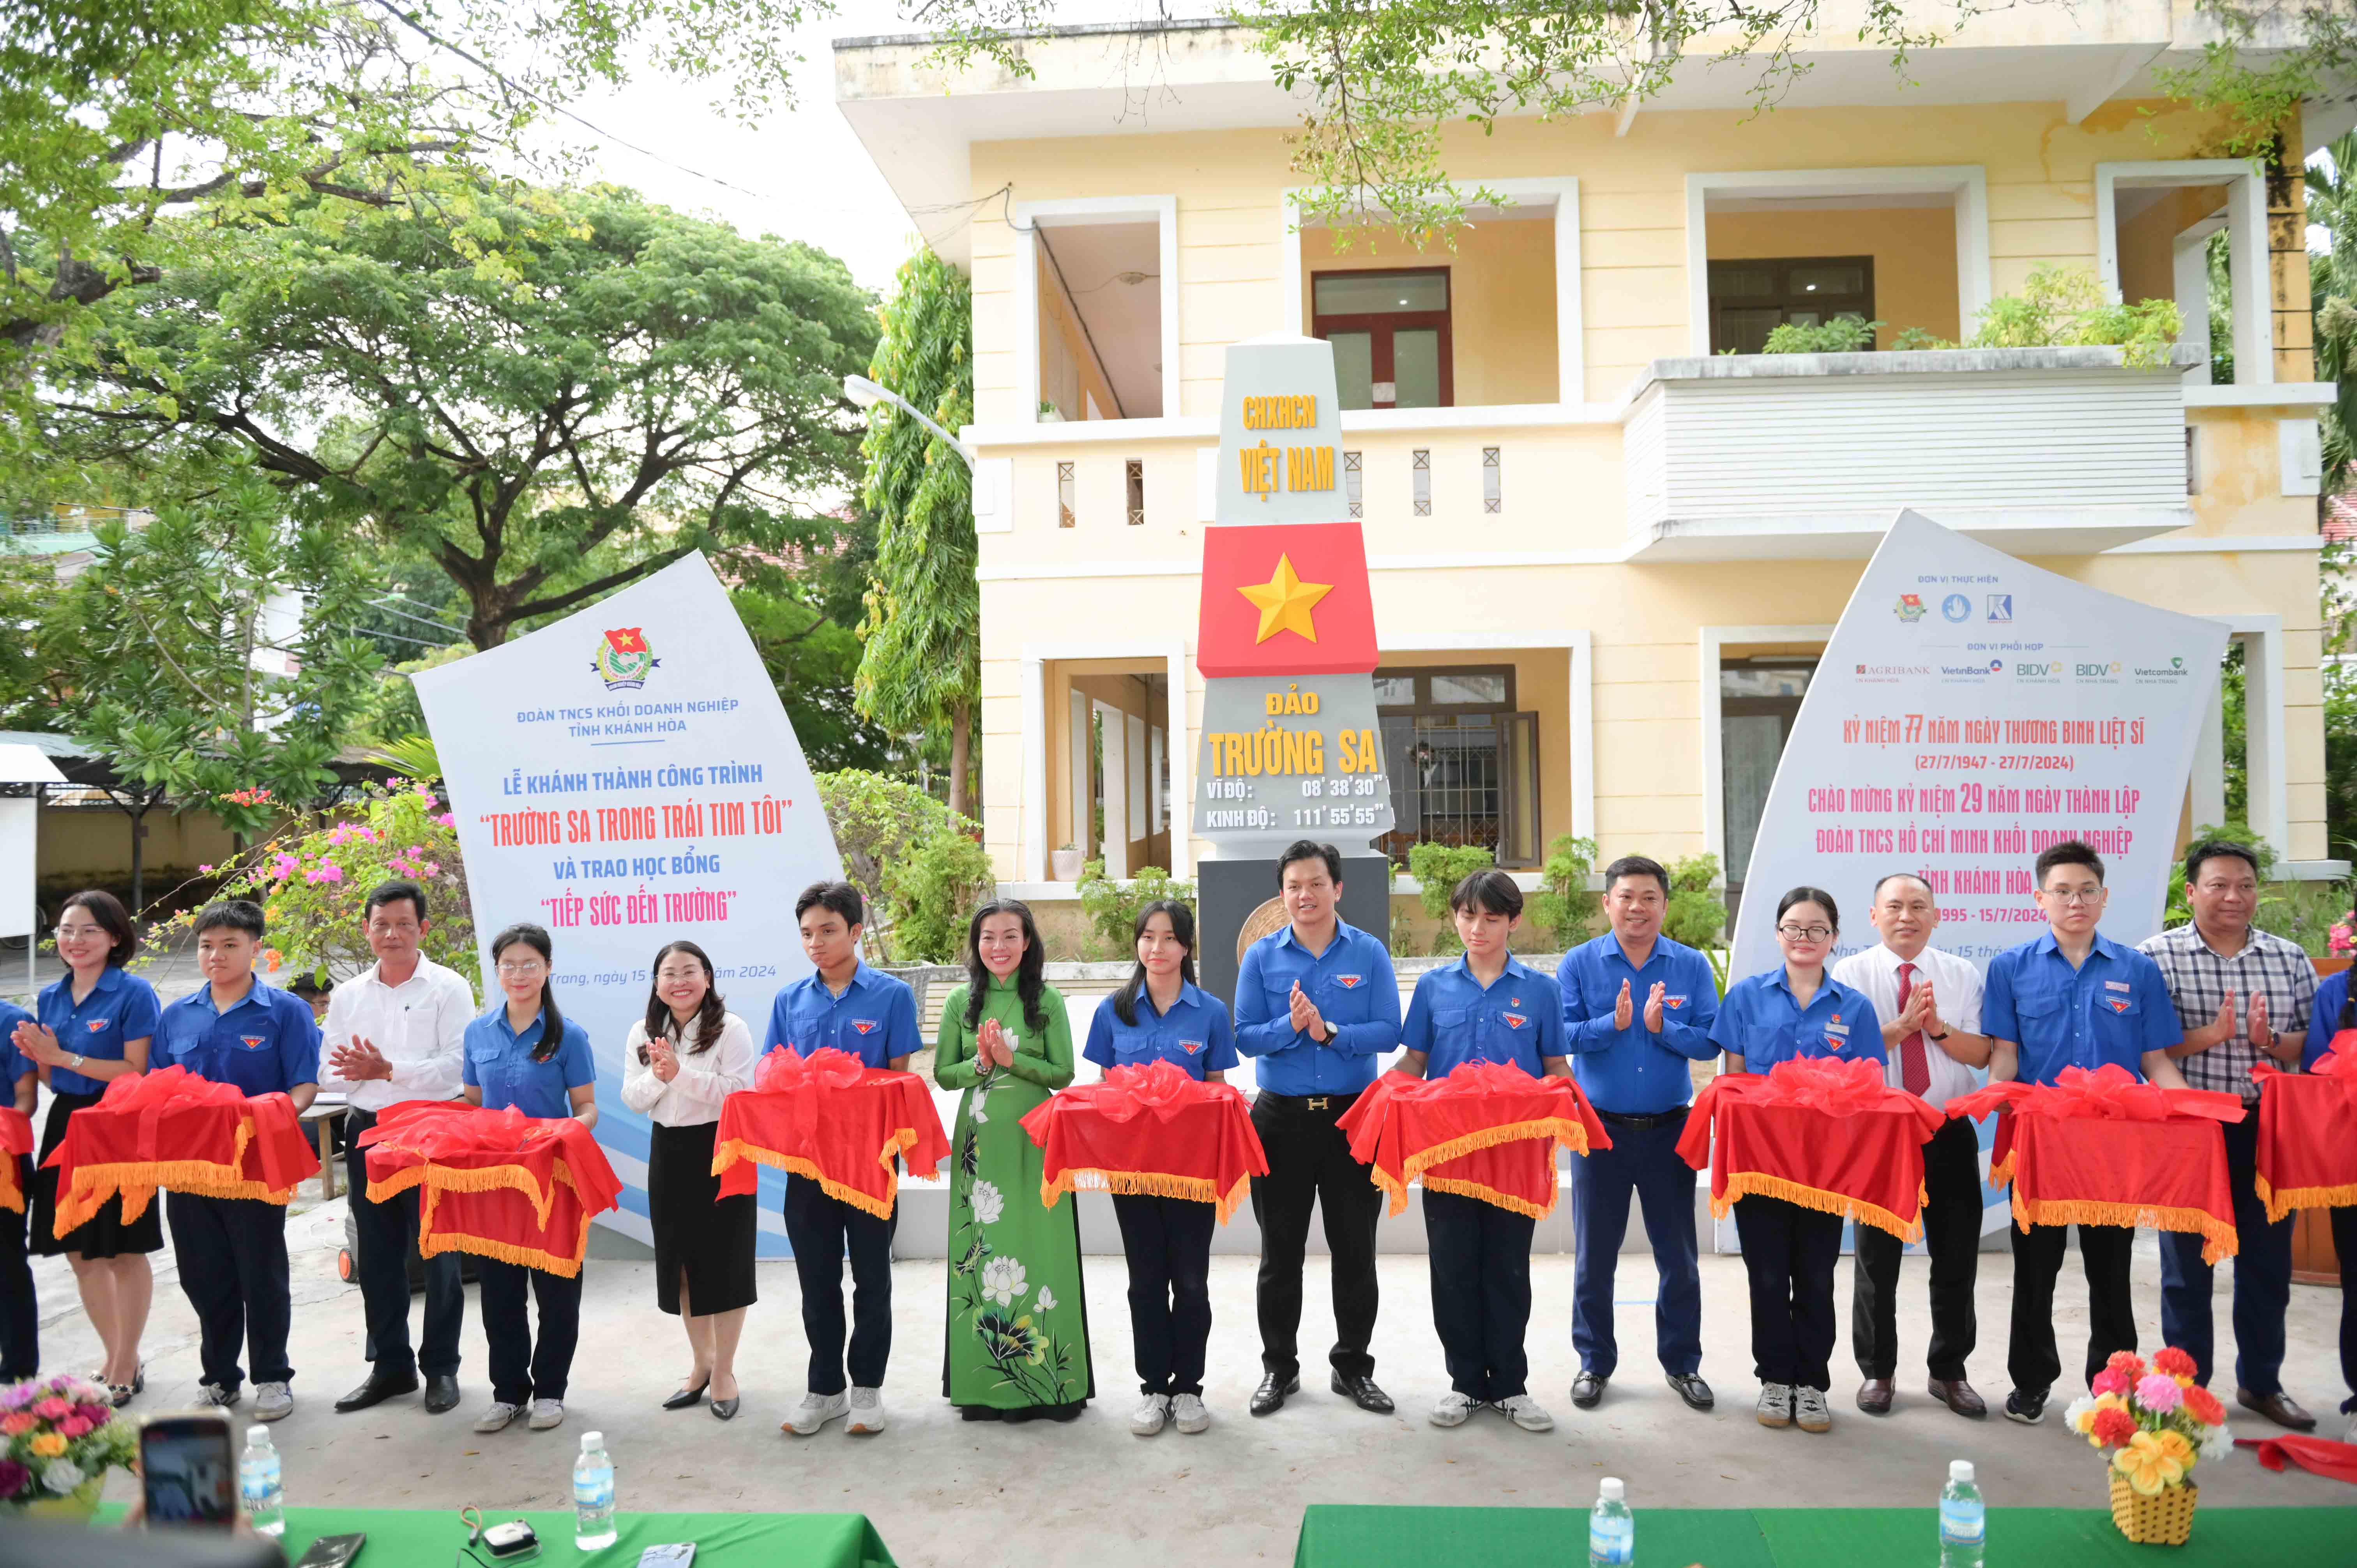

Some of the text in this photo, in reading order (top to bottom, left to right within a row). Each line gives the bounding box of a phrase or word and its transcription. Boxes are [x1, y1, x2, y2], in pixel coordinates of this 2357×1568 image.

[1242, 394, 1316, 430] CHXHCN
[1239, 438, 1334, 502] VIỆT NAM
[1941, 666, 1990, 675] VietinBank
[2017, 664, 2050, 676] BIDV
[2076, 664, 2109, 676] BIDV
[517, 697, 738, 722] ĐOÀN TNCS KHỐI DOANH NGHIỆP
[1266, 683, 1319, 715] ĐẢO
[569, 718, 686, 737] TỈNH KHÁNH HÒA
[1844, 714, 2144, 750] KỶ NIỆM 77 NĂM NGÀY THƯƠNG BINH LIỆT SĨ
[1208, 720, 1378, 776] TRƯỜNG SA
[1915, 755, 1987, 771] (27/7/1947
[2000, 755, 2074, 772] 27/7/2024)
[504, 761, 762, 795] LỄ KHÁNH THÀNH CÔNG TRÌNH
[1207, 779, 1222, 798] VĨ
[1224, 778, 1253, 801] ĐỘ:
[1809, 782, 2140, 819] CHÀO MỪNG KỶ NIỆM 29 NĂM NGÀY THÀNH LẬP
[480, 794, 792, 846] “TRƯỜNG SA TRONG TRÁI TIM TÔI”
[1207, 810, 1244, 827] KINH
[1247, 805, 1276, 829] ĐỘ:
[1816, 825, 1853, 853] ĐOÀN
[1859, 829, 1893, 853] TNCS
[1899, 821, 1917, 853] HỒ
[1922, 825, 1945, 853] CHÍ
[1951, 829, 1988, 853] MINH
[1994, 822, 2026, 854] KHỐI
[2083, 826, 2133, 860] NGHIỆP
[553, 845, 719, 881] VÀ TRAO HỌC BỔNG
[1954, 867, 2000, 894] KHÁNH
[2006, 867, 2032, 894] HÒA
[541, 884, 736, 927] “TIẾP SỨC ĐẾN TRƯỜNG”
[1979, 908, 2051, 925] 15/7/2024
[1958, 946, 1974, 957] 15
[1977, 945, 2007, 957] thá
[549, 973, 589, 986] Trang,
[594, 971, 627, 985] ngày
[631, 970, 645, 981] 15
[714, 965, 777, 979] ăm 2024
